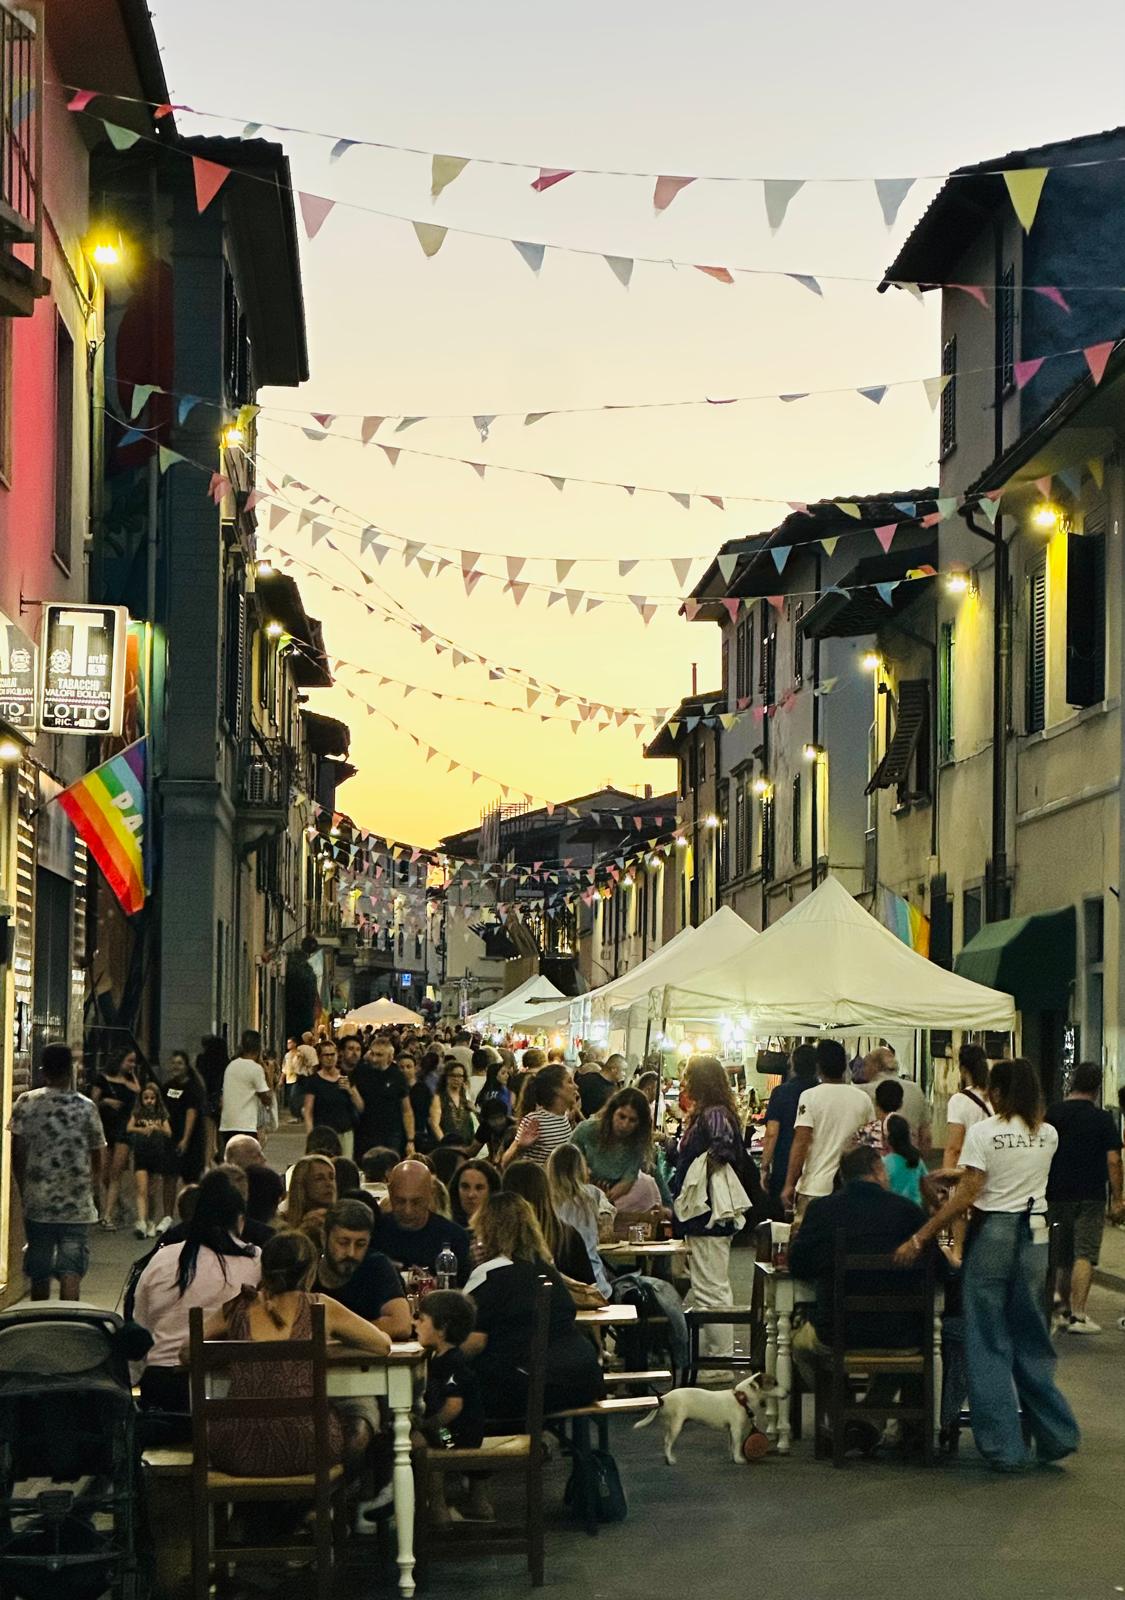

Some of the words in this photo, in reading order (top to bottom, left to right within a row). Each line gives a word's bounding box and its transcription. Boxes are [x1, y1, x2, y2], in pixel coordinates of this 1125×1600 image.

[59, 611, 105, 677] T
[45, 688, 75, 698] VALORI
[76, 690, 111, 699] BOLLATI
[43, 703, 110, 721] LOTTO
[992, 1133, 1047, 1150] STAFF
